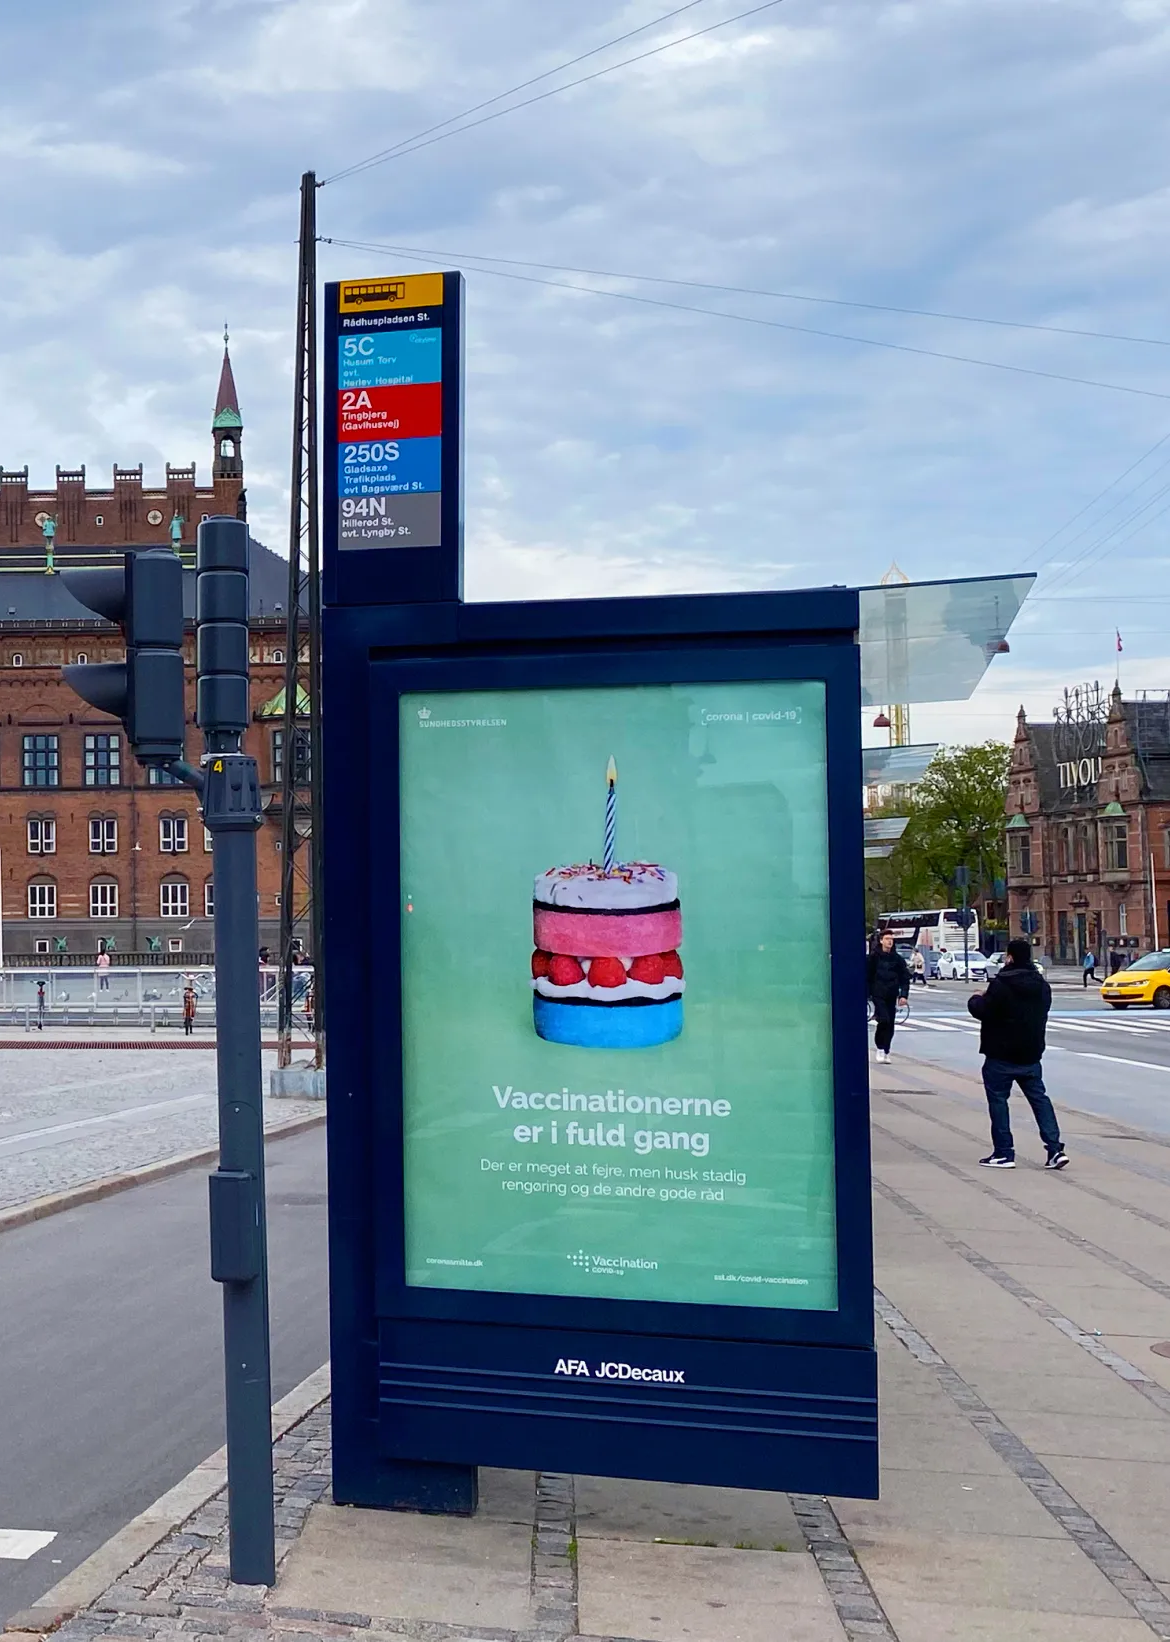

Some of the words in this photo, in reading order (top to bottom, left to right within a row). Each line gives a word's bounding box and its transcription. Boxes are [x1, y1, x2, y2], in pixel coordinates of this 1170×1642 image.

[343, 315, 415, 327] Rådhuspladsen
[417, 313, 430, 321] St.
[343, 336, 375, 357] 5C
[343, 358, 374, 367] Husum
[377, 356, 397, 365] Torv
[343, 378, 372, 387] Herlev
[375, 375, 413, 386] Hospital
[342, 391, 372, 410] 2A
[342, 411, 387, 422] Tingbjerg
[342, 419, 399, 432] (Gavlhusvej)
[344, 442, 400, 464] 250S
[344, 465, 388, 474] Gladsaxe
[344, 474, 396, 484] Trafikplads
[361, 483, 409, 494] Bagsværd
[411, 481, 425, 490] St.
[342, 497, 386, 517] 94N
[381, 517, 394, 525] St.
[342, 530, 359, 538] evt.
[362, 527, 395, 538] Lyngby
[398, 526, 411, 535] St.
[706, 712, 743, 721] corona
[752, 710, 797, 721] covid-19
[419, 719, 507, 728] SUNDHEDSSTYRELSEN
[213, 760, 223, 773] 4
[1056, 756, 1102, 788] TIVOLI
[492, 1085, 732, 1117] Vaccinationerne
[513, 1124, 544, 1143] er
[551, 1121, 558, 1144] i
[566, 1121, 627, 1147] fuld
[633, 1128, 710, 1157] gang
[480, 1158, 505, 1172] Der
[509, 1162, 523, 1172] er
[527, 1162, 571, 1177] meget
[574, 1164, 588, 1176] at
[592, 1163, 625, 1179] fejre,
[629, 1167, 661, 1179] men
[665, 1166, 699, 1181] husk
[702, 1169, 747, 1186] stadig
[502, 1179, 567, 1196] rengøring
[571, 1184, 589, 1197] og
[593, 1182, 612, 1196] de
[615, 1184, 656, 1198] andre
[660, 1186, 697, 1201] gode
[701, 1186, 725, 1201] råd
[592, 1255, 658, 1270] Vaccination
[714, 1274, 809, 1285] sst.dk/covid-vaccination
[554, 1358, 590, 1376] AFA
[595, 1362, 685, 1383] JCDecaux
